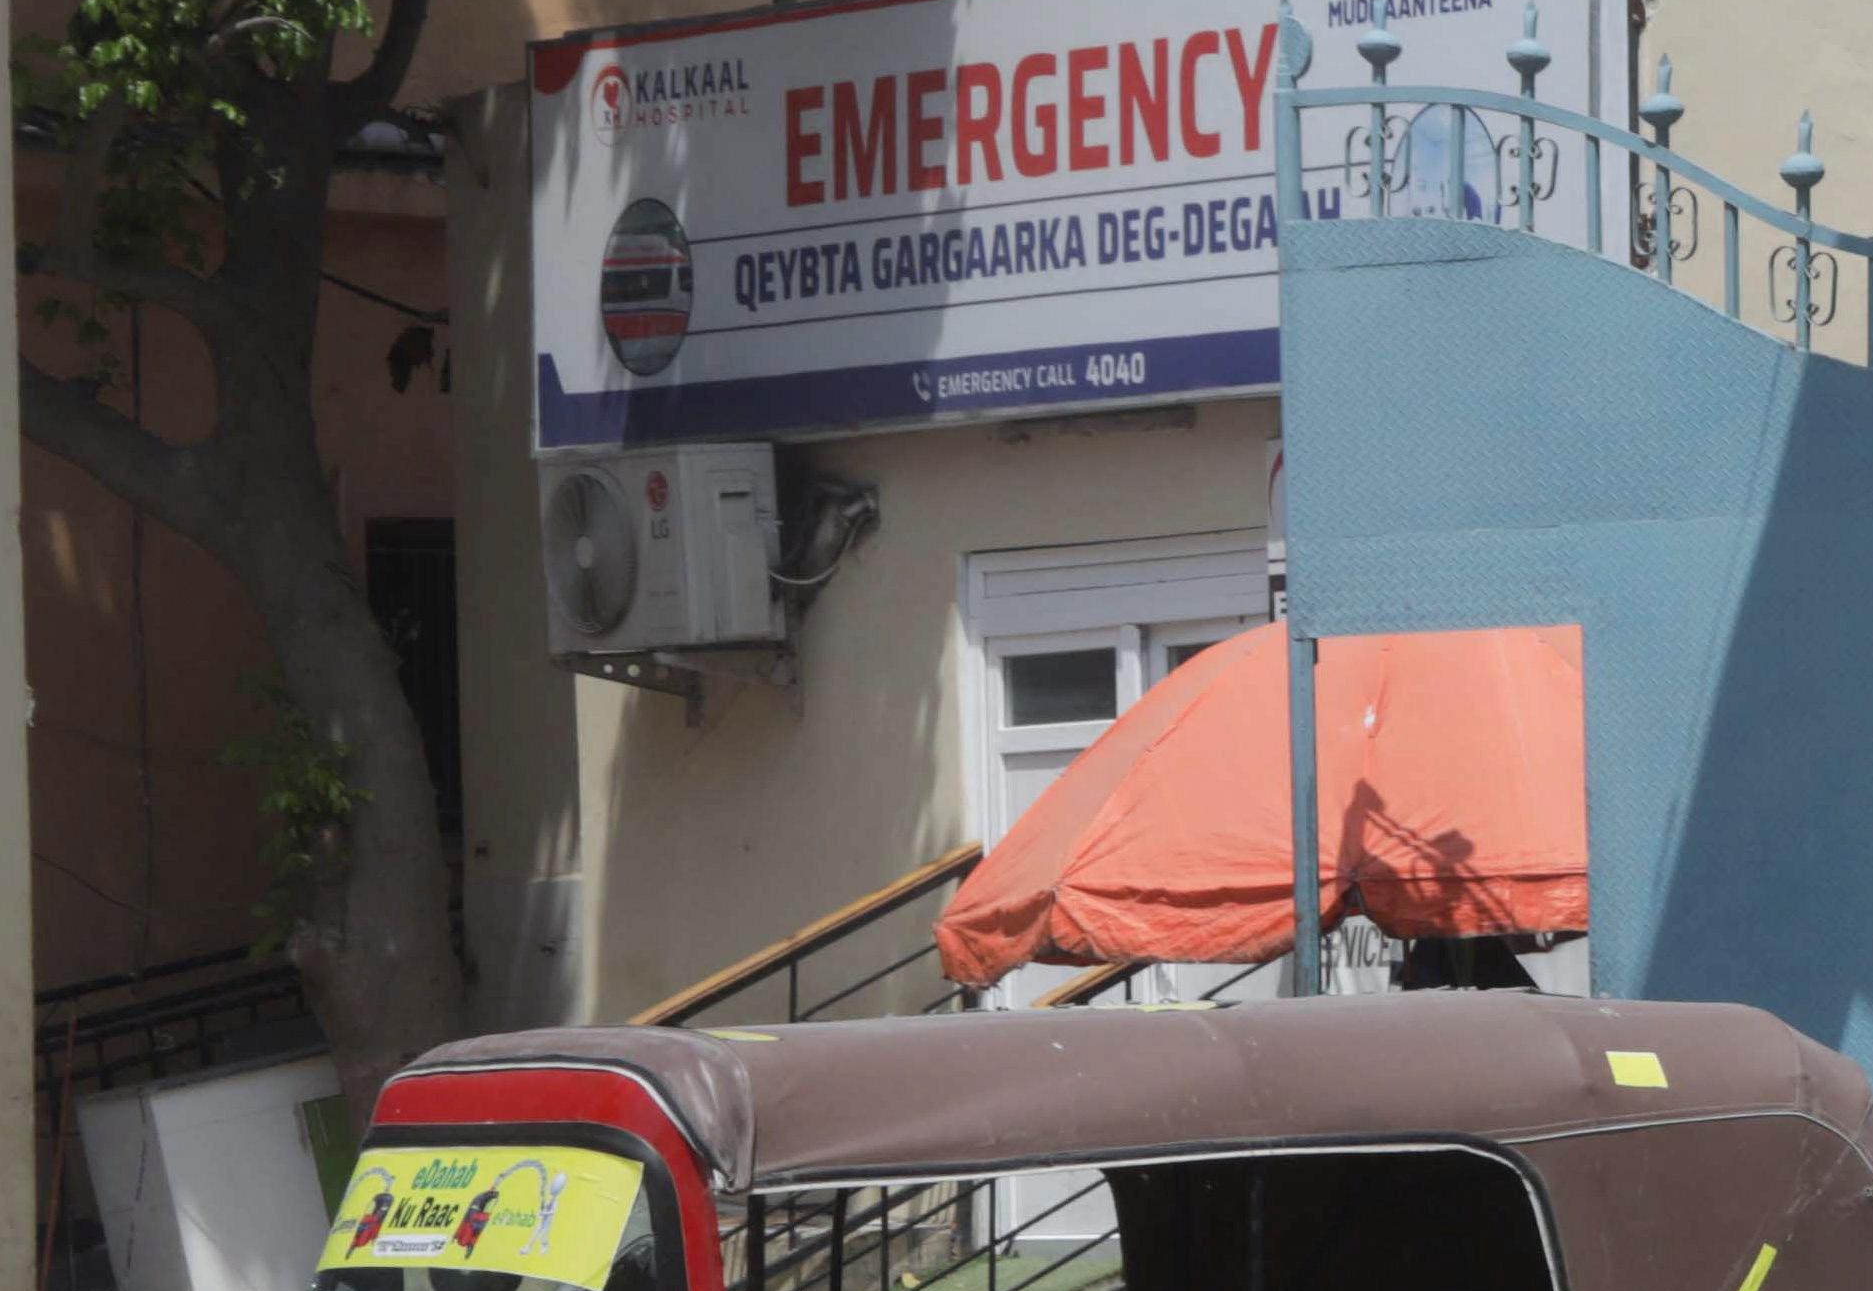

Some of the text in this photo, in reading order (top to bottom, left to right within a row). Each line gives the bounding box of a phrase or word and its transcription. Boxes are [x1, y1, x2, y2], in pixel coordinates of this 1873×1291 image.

[636, 59, 750, 104] KALKAAL
[635, 97, 750, 128] HOSPITAL
[783, 22, 1280, 208] EMERGENCY
[734, 240, 863, 312] QEYBTA
[872, 212, 1087, 293] GARGAARKA
[937, 350, 1146, 400] EMERGENCY CALL 4040
[650, 516, 670, 540] LG
[411, 1157, 479, 1191] eDahab
[388, 1196, 413, 1228] Ku
[414, 1197, 460, 1228] Raac
